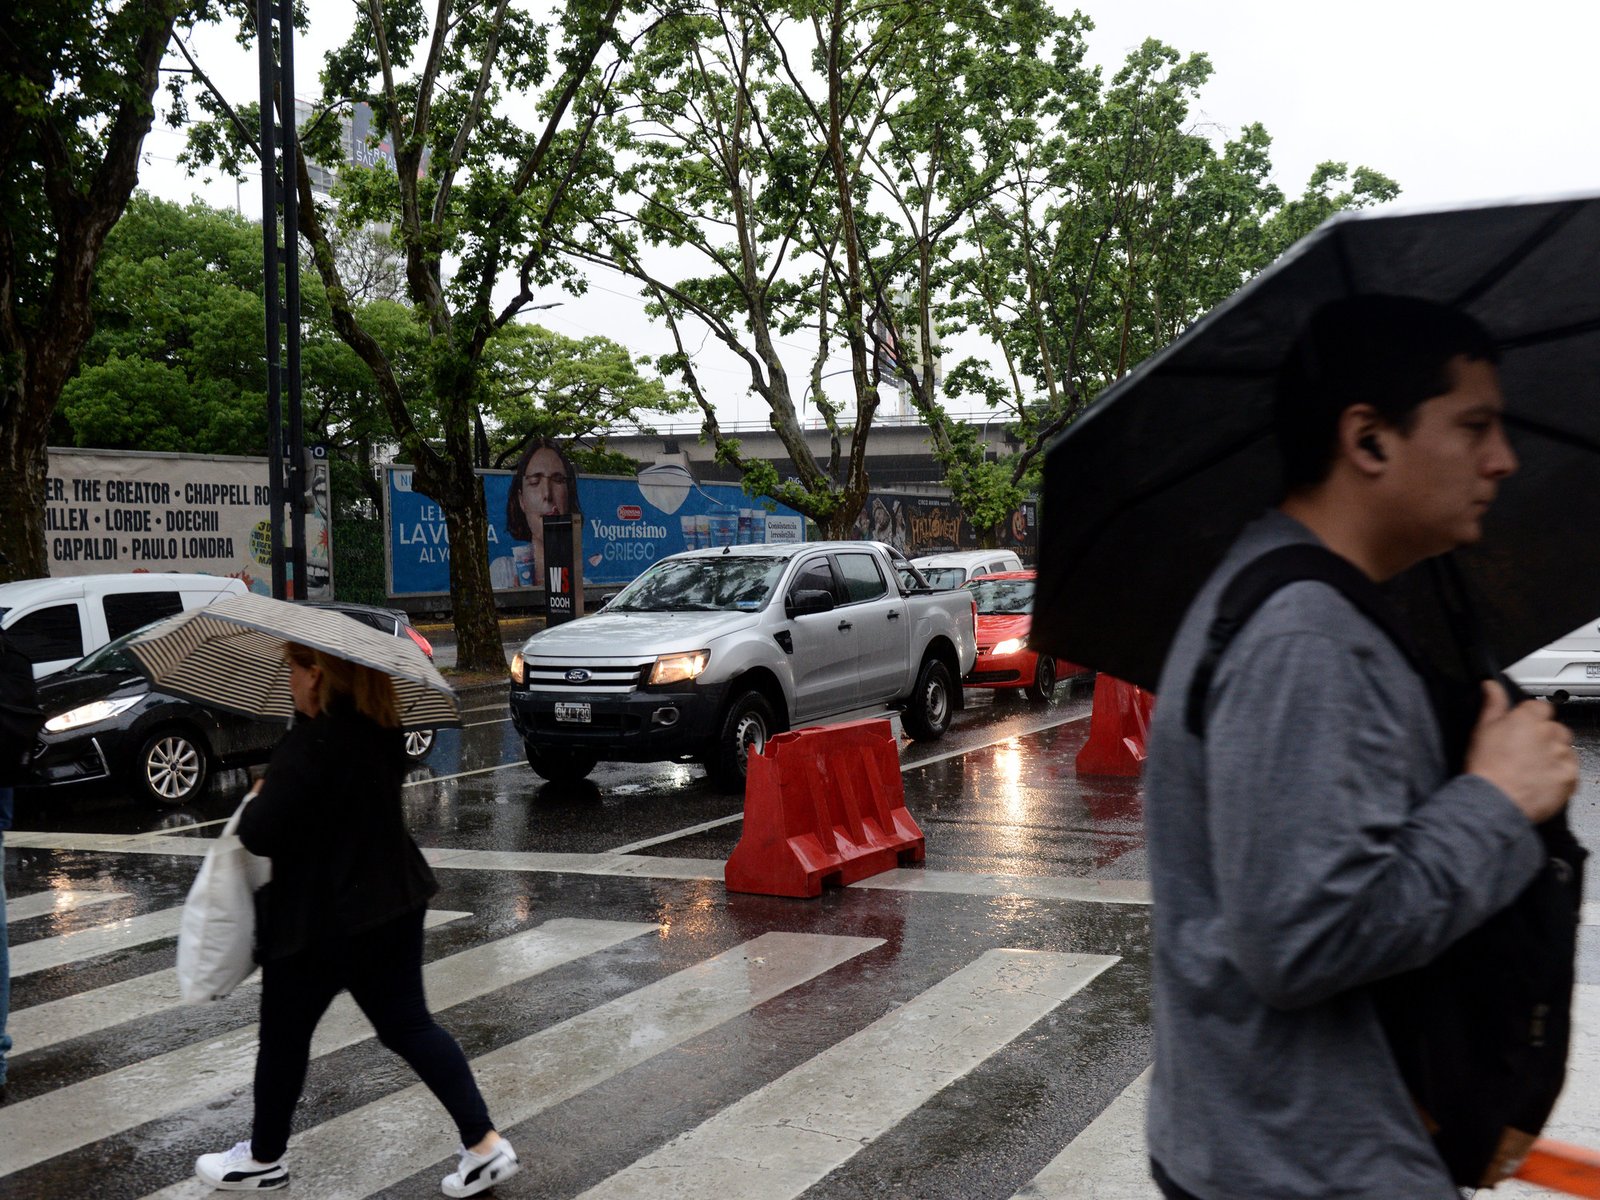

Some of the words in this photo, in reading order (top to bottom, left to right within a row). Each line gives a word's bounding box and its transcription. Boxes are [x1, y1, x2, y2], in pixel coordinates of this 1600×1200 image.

[72, 479, 102, 502] THE
[106, 480, 170, 504] CREATOR
[185, 483, 250, 506] CHAPPELL
[45, 508, 89, 531] ILLEX
[105, 509, 151, 532] LORDE
[166, 510, 219, 532] DOECHII
[421, 505, 435, 521] LE
[400, 523, 428, 545] LA
[54, 538, 118, 561] CAPALDI
[132, 538, 178, 560] PAULO
[182, 537, 234, 559] LONDRA
[419, 547, 436, 563] AL
[604, 542, 655, 560] GRIEGO
[550, 567, 570, 593] WS
[550, 597, 570, 608] DOOH
